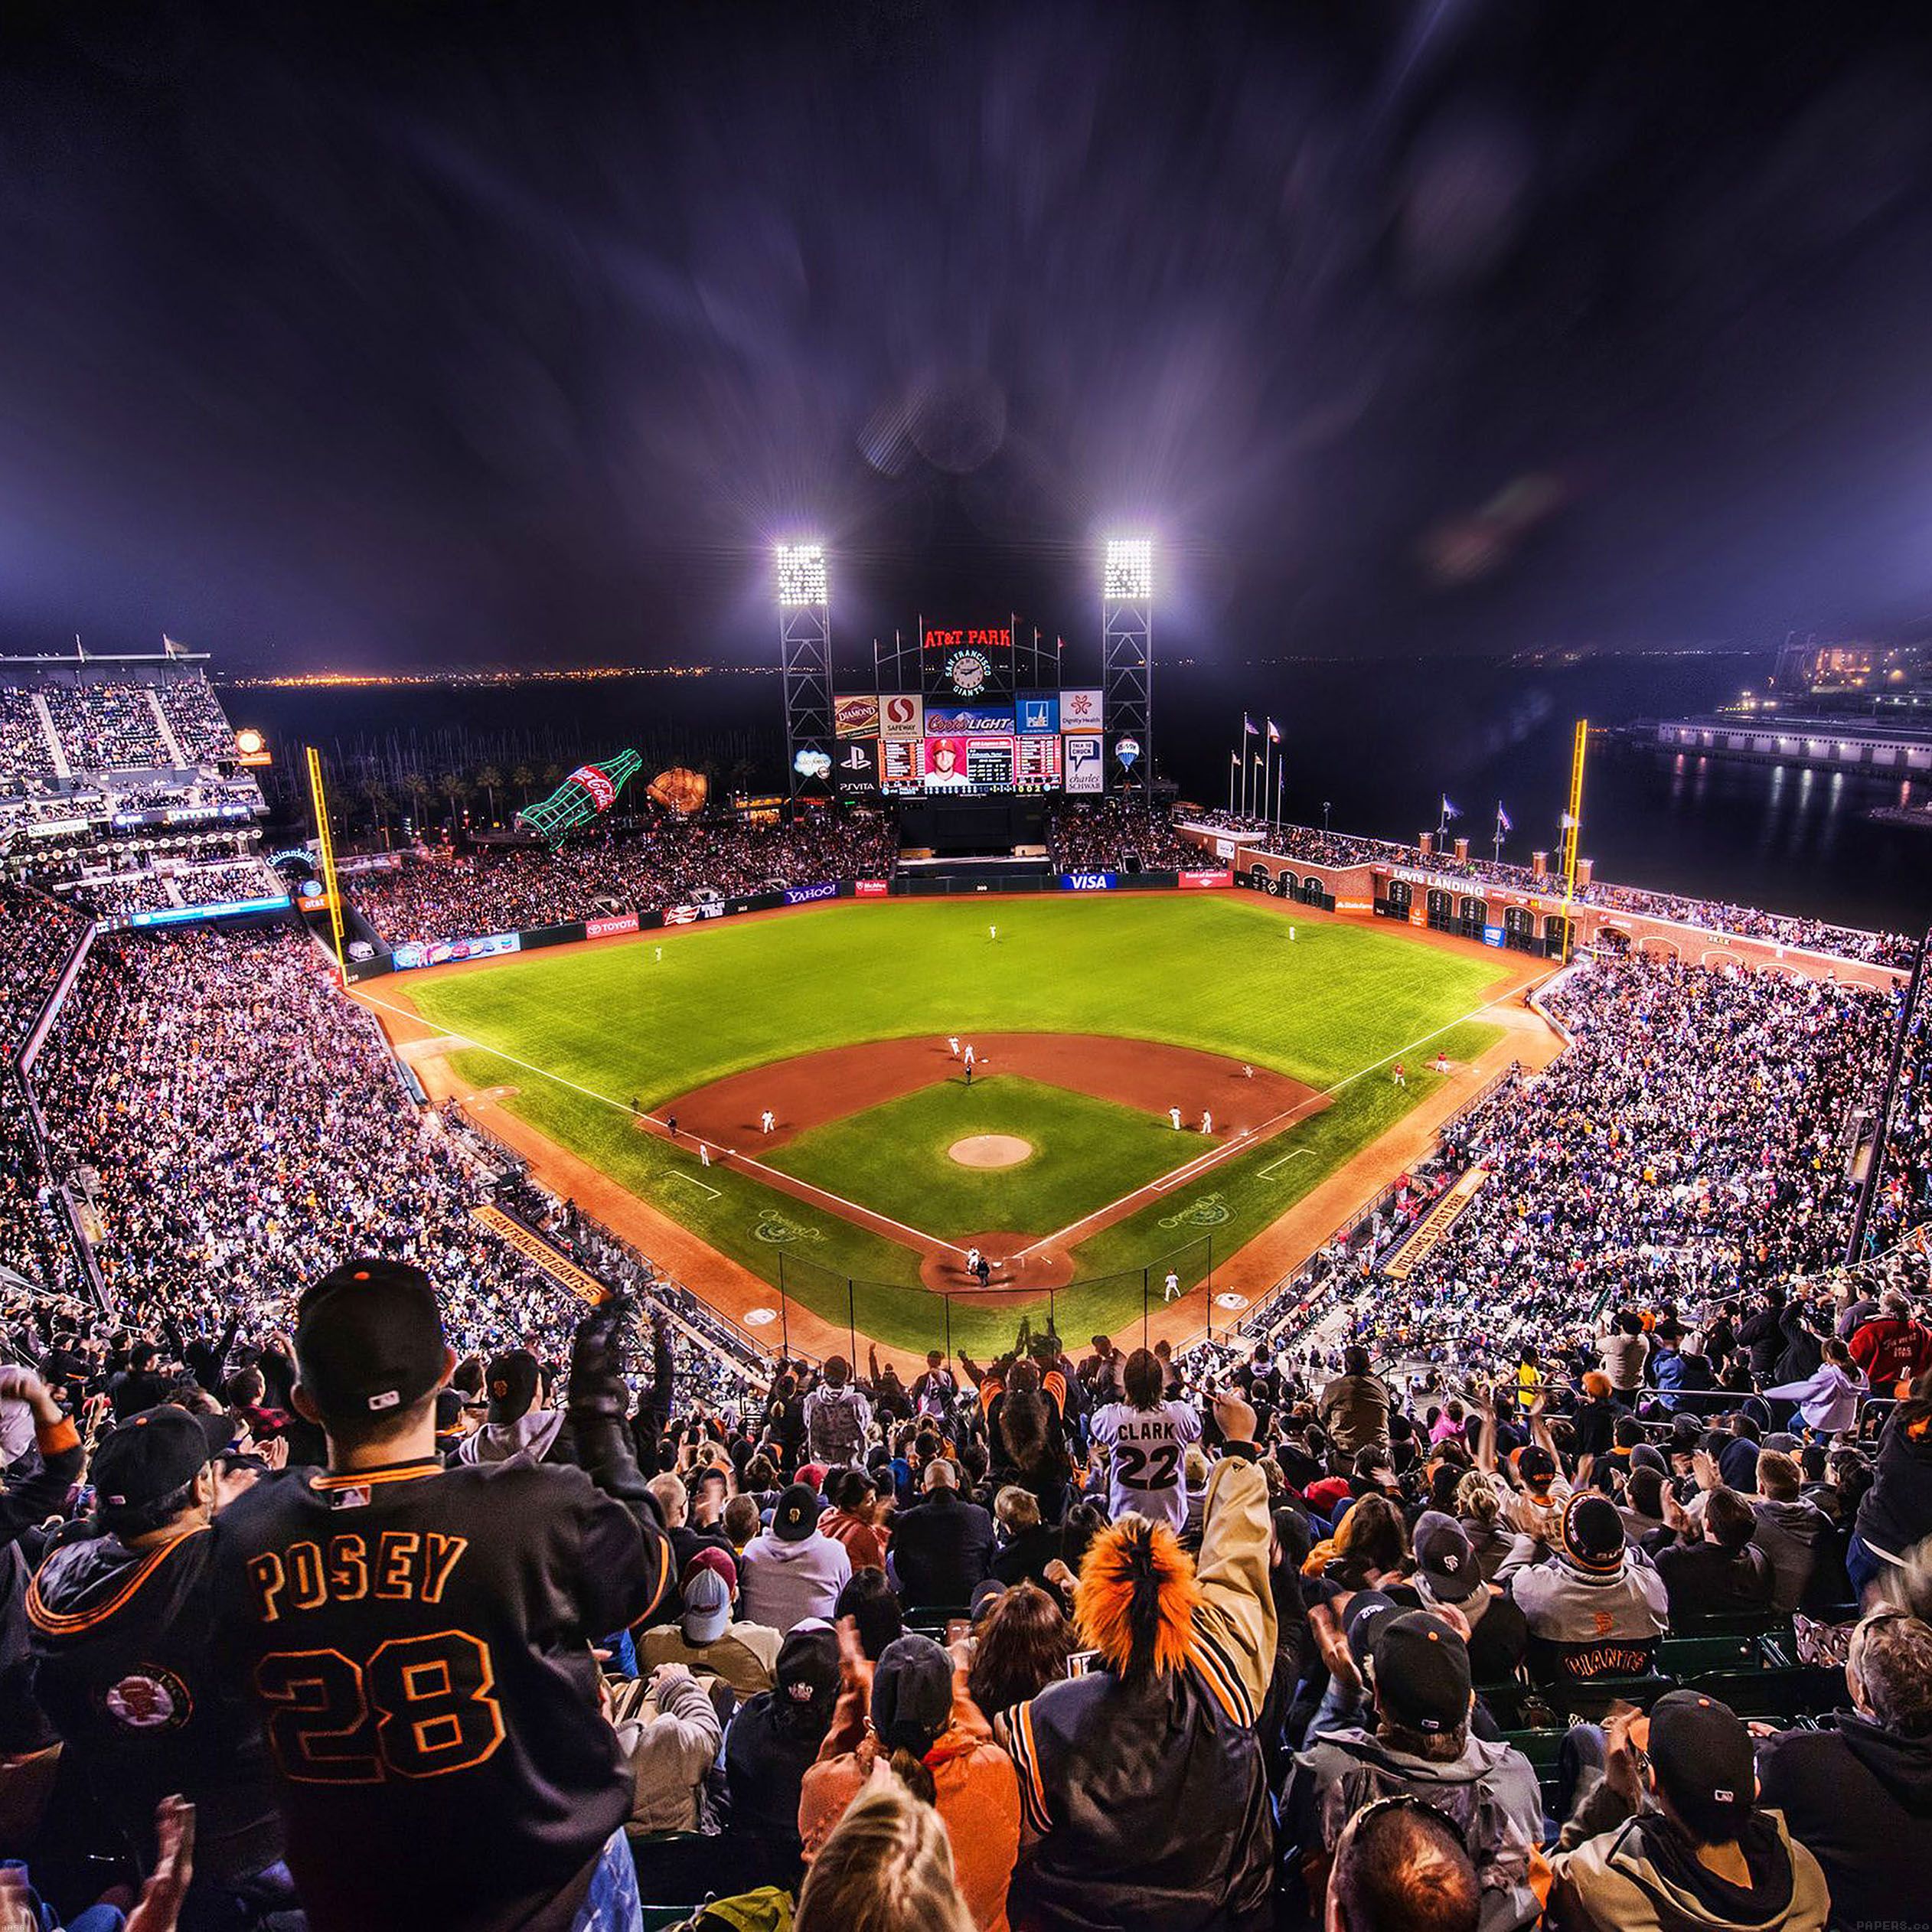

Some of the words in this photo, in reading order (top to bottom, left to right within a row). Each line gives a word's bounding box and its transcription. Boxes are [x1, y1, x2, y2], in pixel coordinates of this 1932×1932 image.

[924, 631, 963, 648] AT&T
[968, 629, 1010, 647] PARK
[945, 658, 955, 677] SAN
[954, 650, 991, 676] FRANCISCO
[953, 684, 984, 696] GIANTS
[838, 707, 876, 721] DIAMOND
[928, 714, 967, 733] Coors
[968, 718, 1011, 730] LIGHT
[1069, 773, 1098, 782] charles
[266, 848, 315, 866] Ghirardelli
[1069, 876, 1107, 889] VISA
[1427, 875, 1484, 896] LANDING
[786, 884, 836, 903] YAHOO!
[602, 919, 638, 932] TOYOTA
[1431, 1209, 1453, 1229] AT&T
[1425, 1225, 1440, 1237] TO
[488, 1216, 509, 1235] SAN
[504, 1228, 554, 1265] FRANCISCO
[547, 1260, 590, 1290] GIANTS
[1392, 1232, 1431, 1271] WELCOME
[1118, 1423, 1176, 1441] CLARK
[1115, 1444, 1180, 1491] 22
[247, 1531, 468, 1623] POSEY
[1564, 1648, 1647, 1677] GIANTS
[253, 1629, 507, 1784] 28
